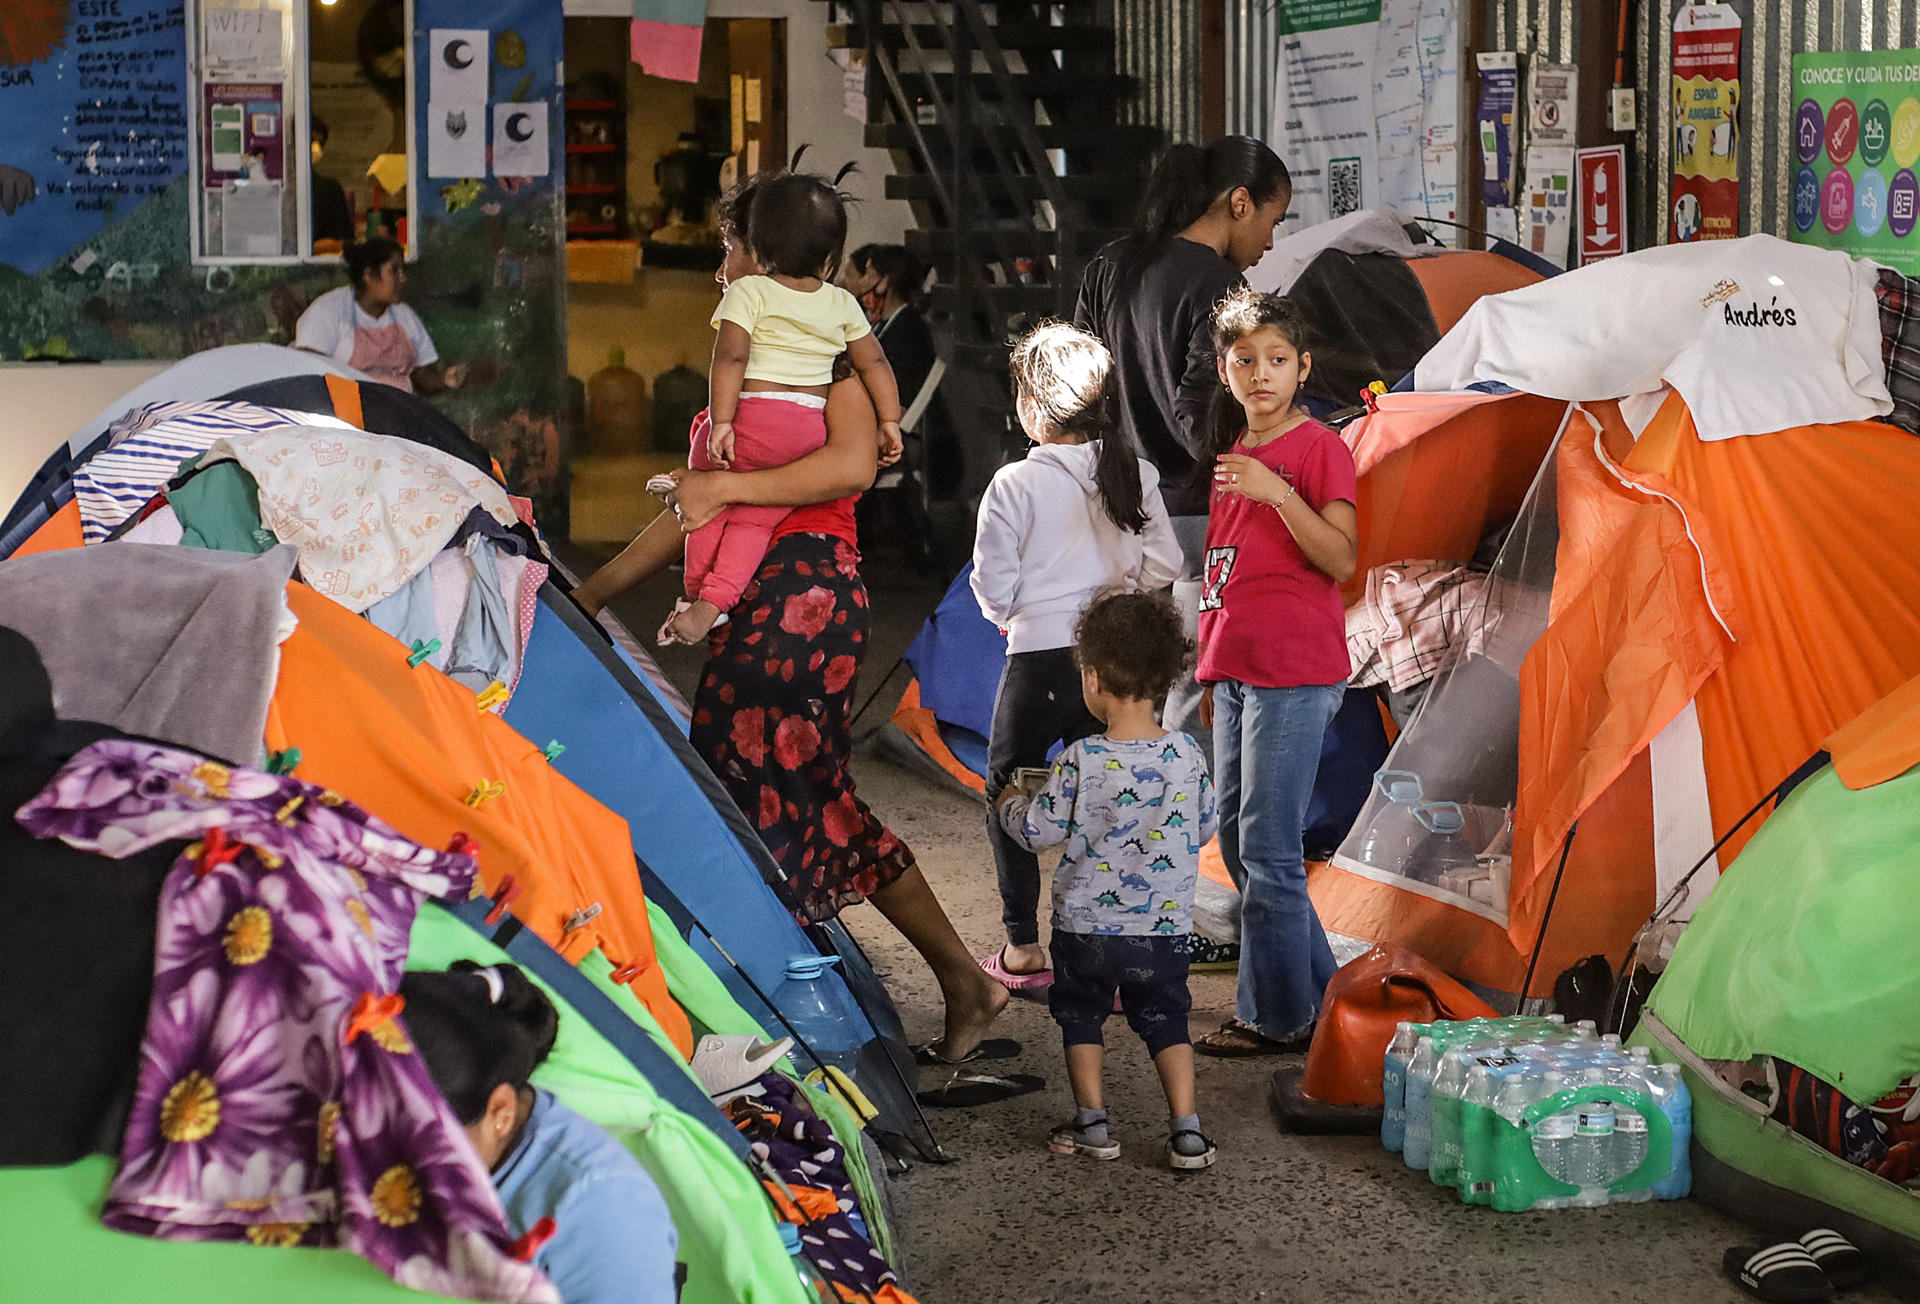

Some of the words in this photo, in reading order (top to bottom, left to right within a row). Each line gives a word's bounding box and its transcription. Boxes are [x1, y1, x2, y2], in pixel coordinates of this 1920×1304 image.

[79, 1, 122, 16] ESTE
[1, 70, 34, 88] SUR
[1800, 67, 1843, 84] CONOCE
[1846, 68, 1854, 83] Y
[1855, 66, 1882, 83] CUIDA
[1885, 66, 1902, 82] TUS
[1724, 295, 1797, 328] Andrés
